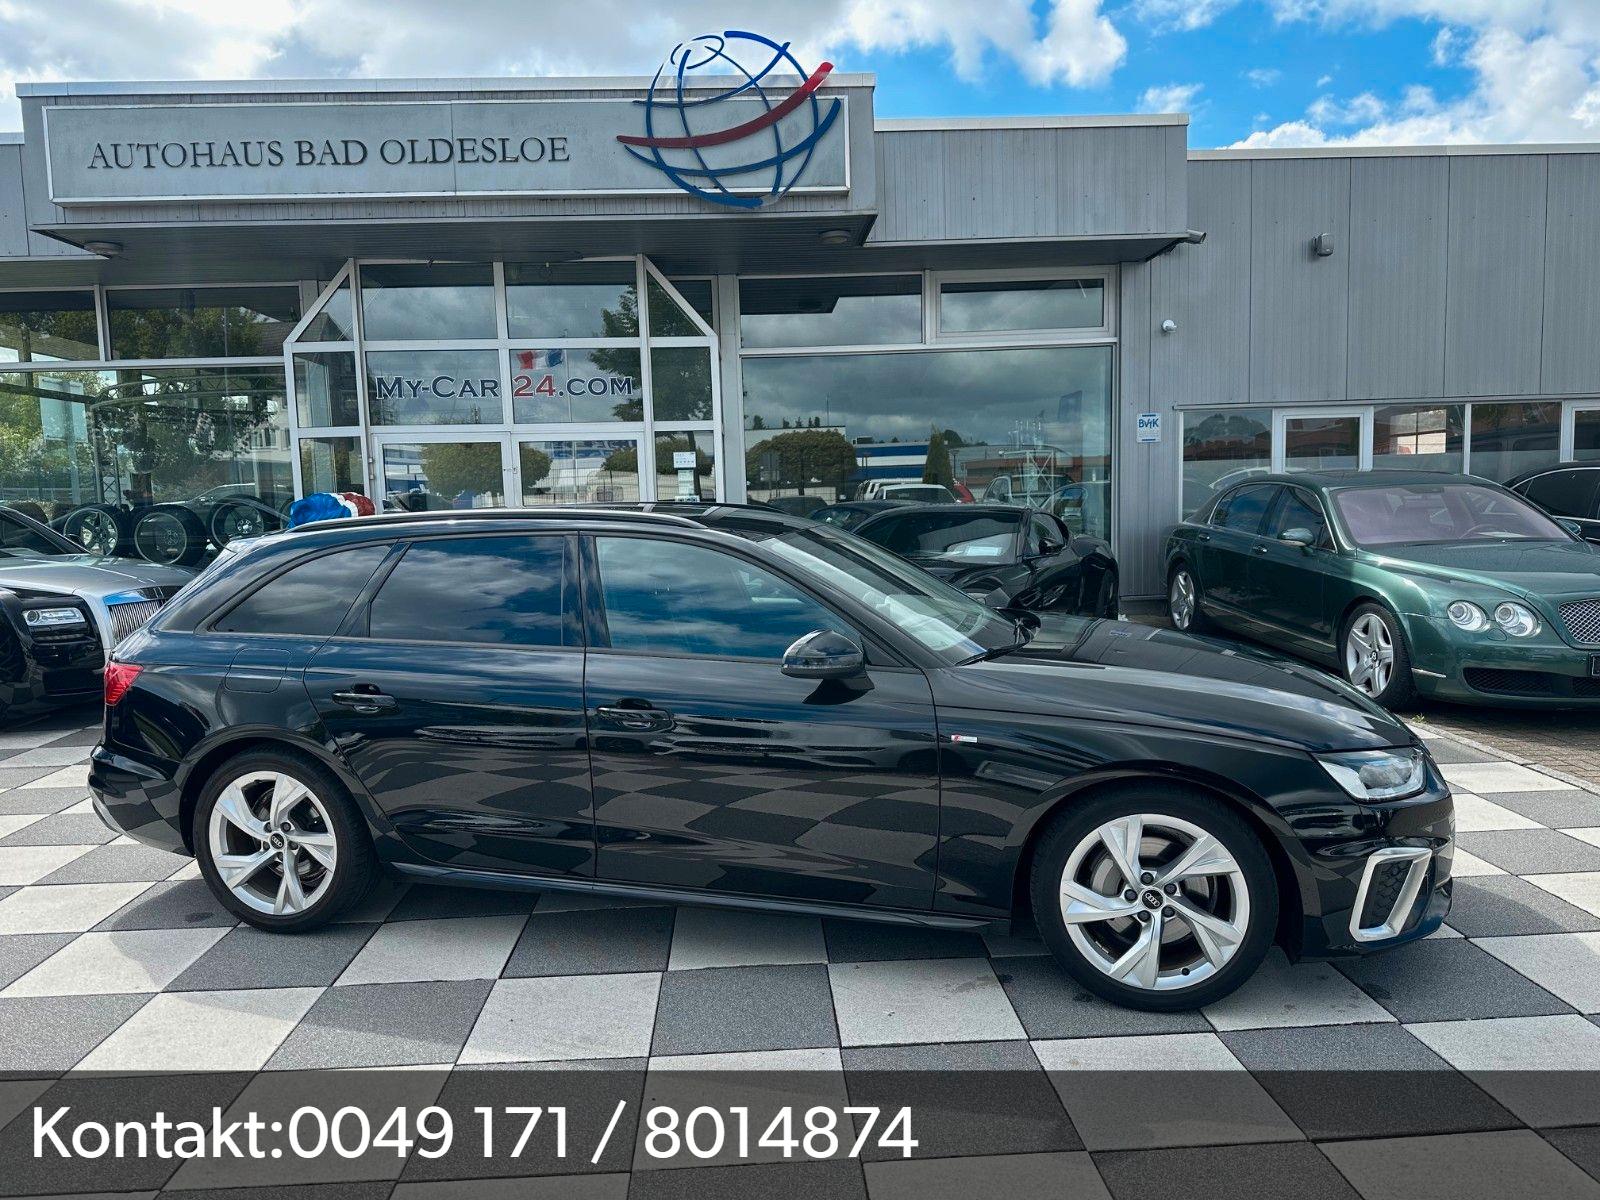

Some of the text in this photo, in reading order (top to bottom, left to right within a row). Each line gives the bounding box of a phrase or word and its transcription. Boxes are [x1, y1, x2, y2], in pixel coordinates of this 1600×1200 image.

[87, 136, 570, 169] AUTOHAUS BAD OLDESLOE
